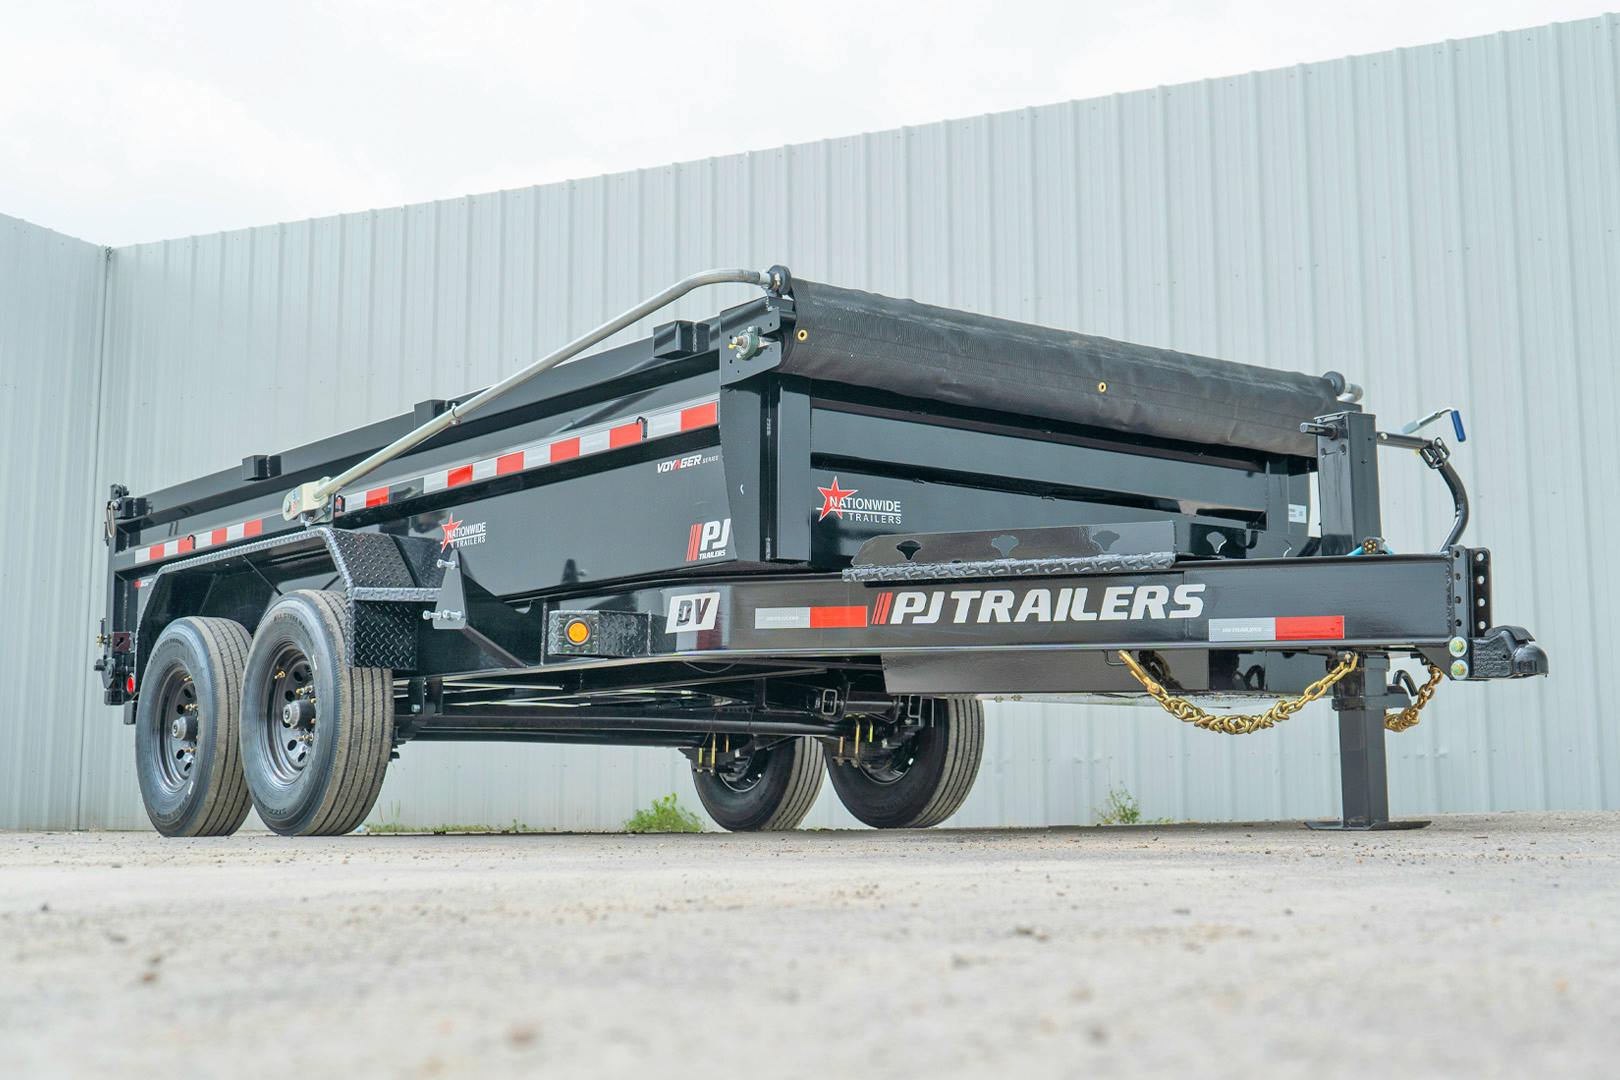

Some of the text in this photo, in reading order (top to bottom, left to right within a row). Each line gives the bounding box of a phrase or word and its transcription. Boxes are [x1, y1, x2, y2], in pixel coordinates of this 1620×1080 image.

[657, 454, 702, 473] VOYAGER
[829, 496, 902, 512] NATIONWIDE
[848, 513, 902, 525] TRAILERS
[447, 522, 487, 538] NATIONWIDE
[700, 518, 731, 551] PJ
[456, 535, 486, 548] TRAILERS
[699, 549, 726, 560] TRAILERS
[890, 583, 1206, 624] PJ TRAILERS
[676, 597, 712, 627] DV
